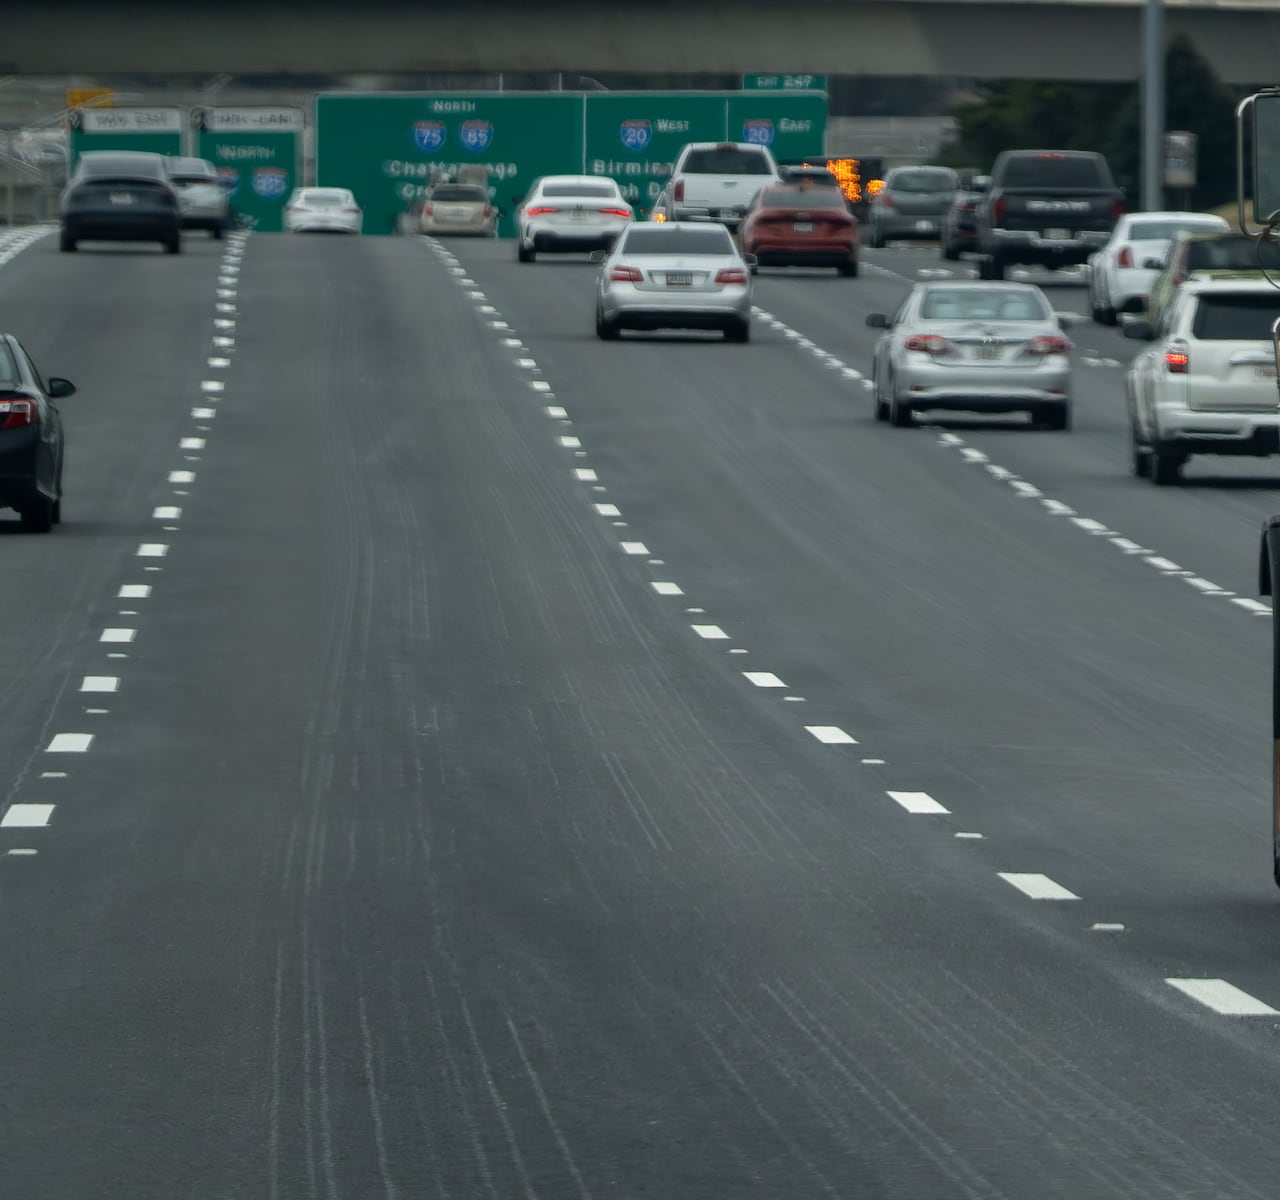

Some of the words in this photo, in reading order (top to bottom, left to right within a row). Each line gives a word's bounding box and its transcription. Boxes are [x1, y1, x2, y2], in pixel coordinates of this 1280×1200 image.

[433, 101, 475, 113] NORTH
[656, 118, 690, 131] WEST
[422, 129, 441, 145] 75
[467, 129, 487, 145] 85
[626, 128, 647, 143] 20
[748, 128, 769, 143] 20
